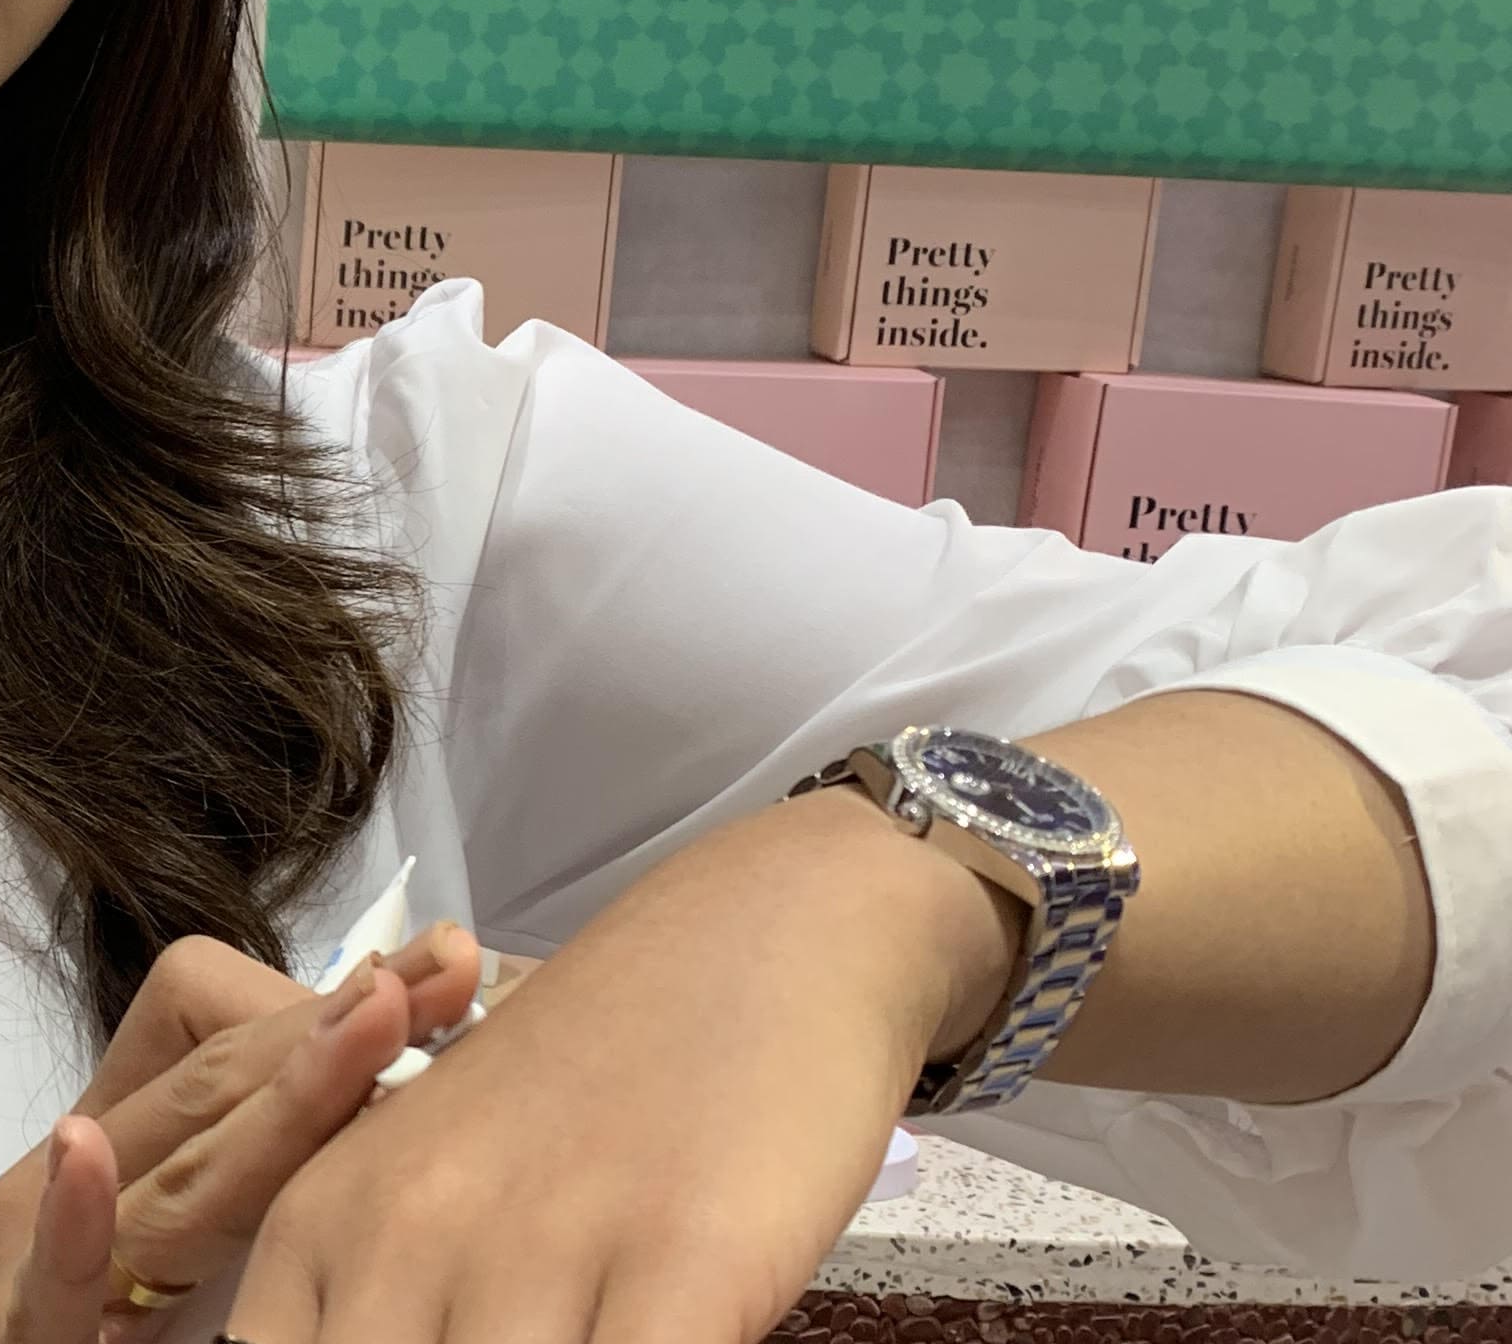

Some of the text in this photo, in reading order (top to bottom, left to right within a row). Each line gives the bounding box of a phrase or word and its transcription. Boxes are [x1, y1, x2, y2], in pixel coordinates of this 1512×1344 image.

[342, 219, 451, 260] Pretty
[887, 236, 996, 277] Pretty
[881, 275, 989, 316] things
[1364, 261, 1463, 300] Pretty
[876, 316, 988, 349] inside.
[1357, 298, 1454, 338] things
[1350, 339, 1450, 370] inside.
[1128, 494, 1257, 536] Pretty
